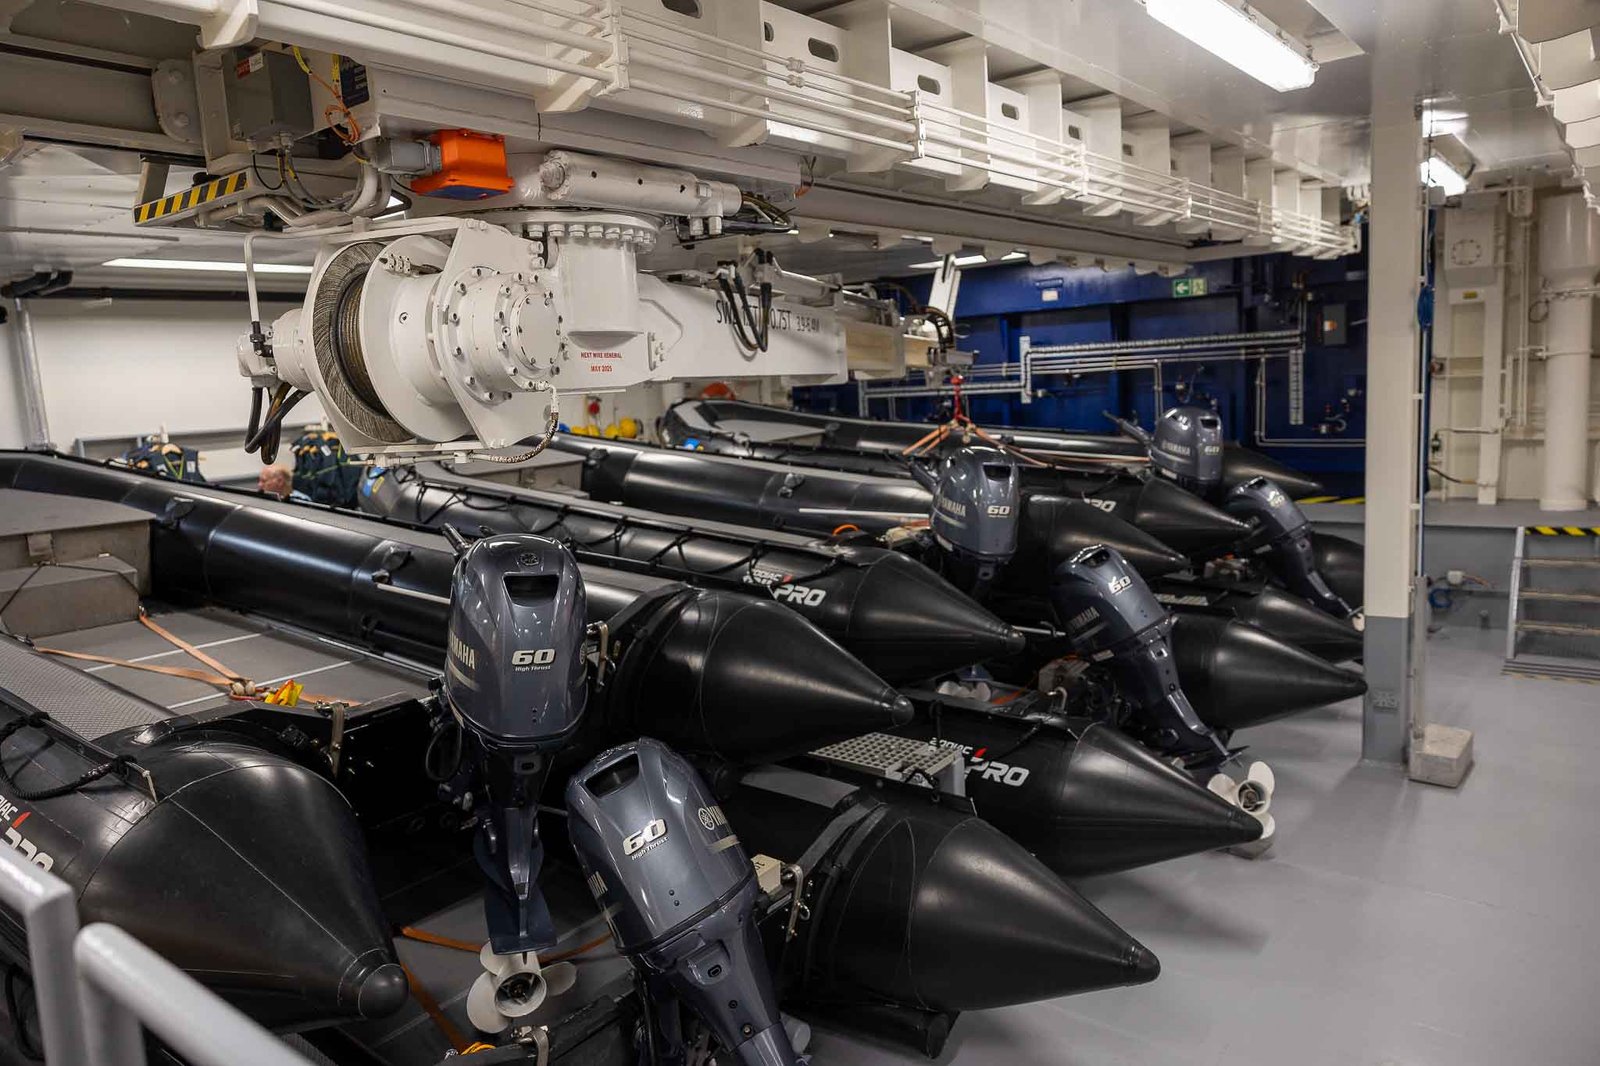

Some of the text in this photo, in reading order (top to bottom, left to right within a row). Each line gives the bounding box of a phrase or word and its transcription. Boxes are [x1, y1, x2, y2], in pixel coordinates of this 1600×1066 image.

[770, 307, 791, 330] 0.75T
[580, 351, 622, 359] NEXT WIRE RENEWAL
[987, 505, 1011, 515] 60
[1108, 575, 1132, 594] 60
[512, 648, 556, 666] 60
[622, 818, 667, 856] 60
[631, 831, 669, 861] High Thrust
